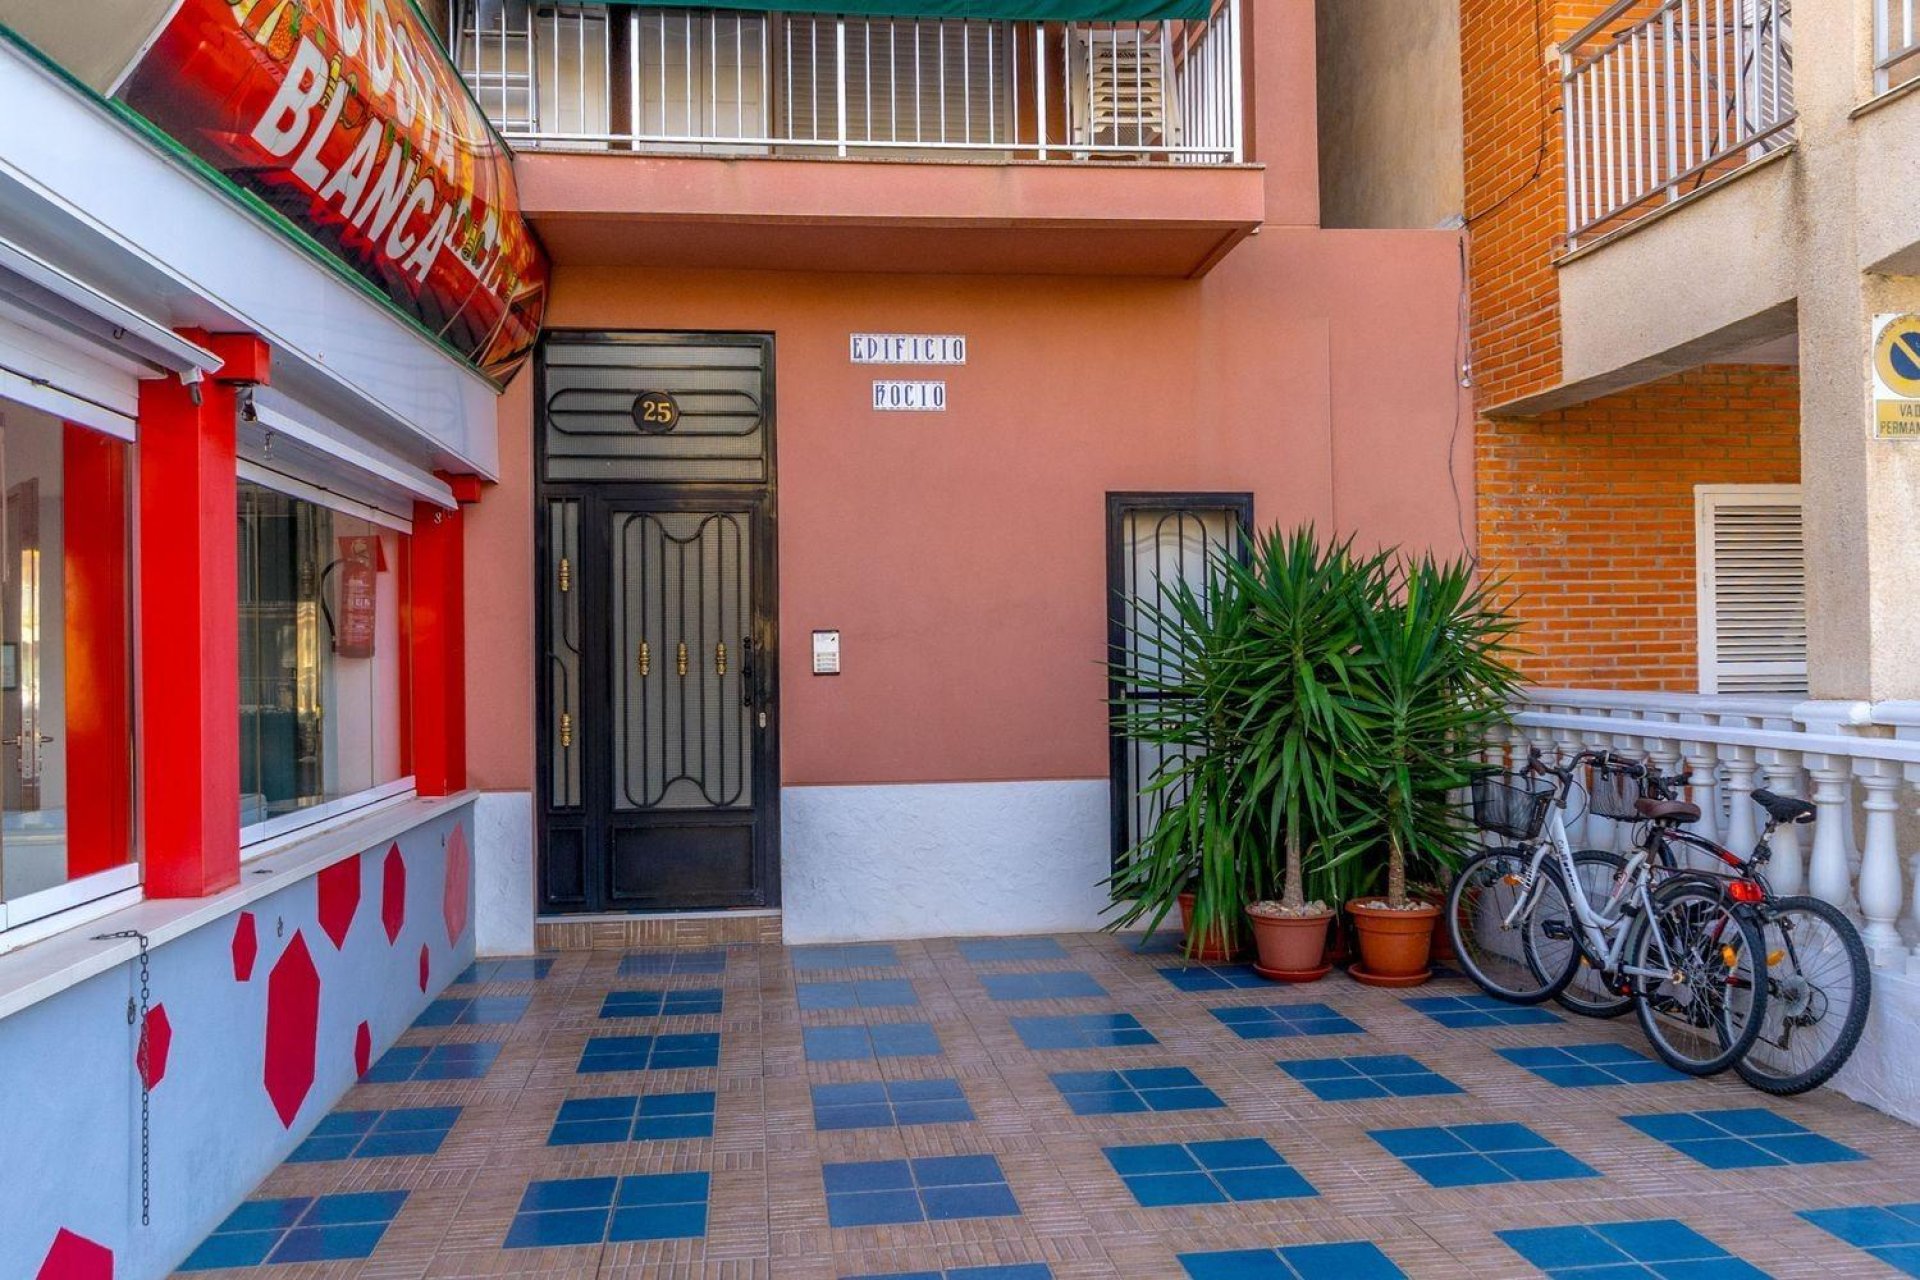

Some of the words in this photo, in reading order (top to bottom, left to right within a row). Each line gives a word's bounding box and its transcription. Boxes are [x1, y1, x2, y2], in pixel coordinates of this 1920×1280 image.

[251, 37, 452, 283] BLANCA
[852, 337, 964, 361] EDIFICIO
[874, 384, 944, 408] ROCIO
[642, 400, 672, 423] 25
